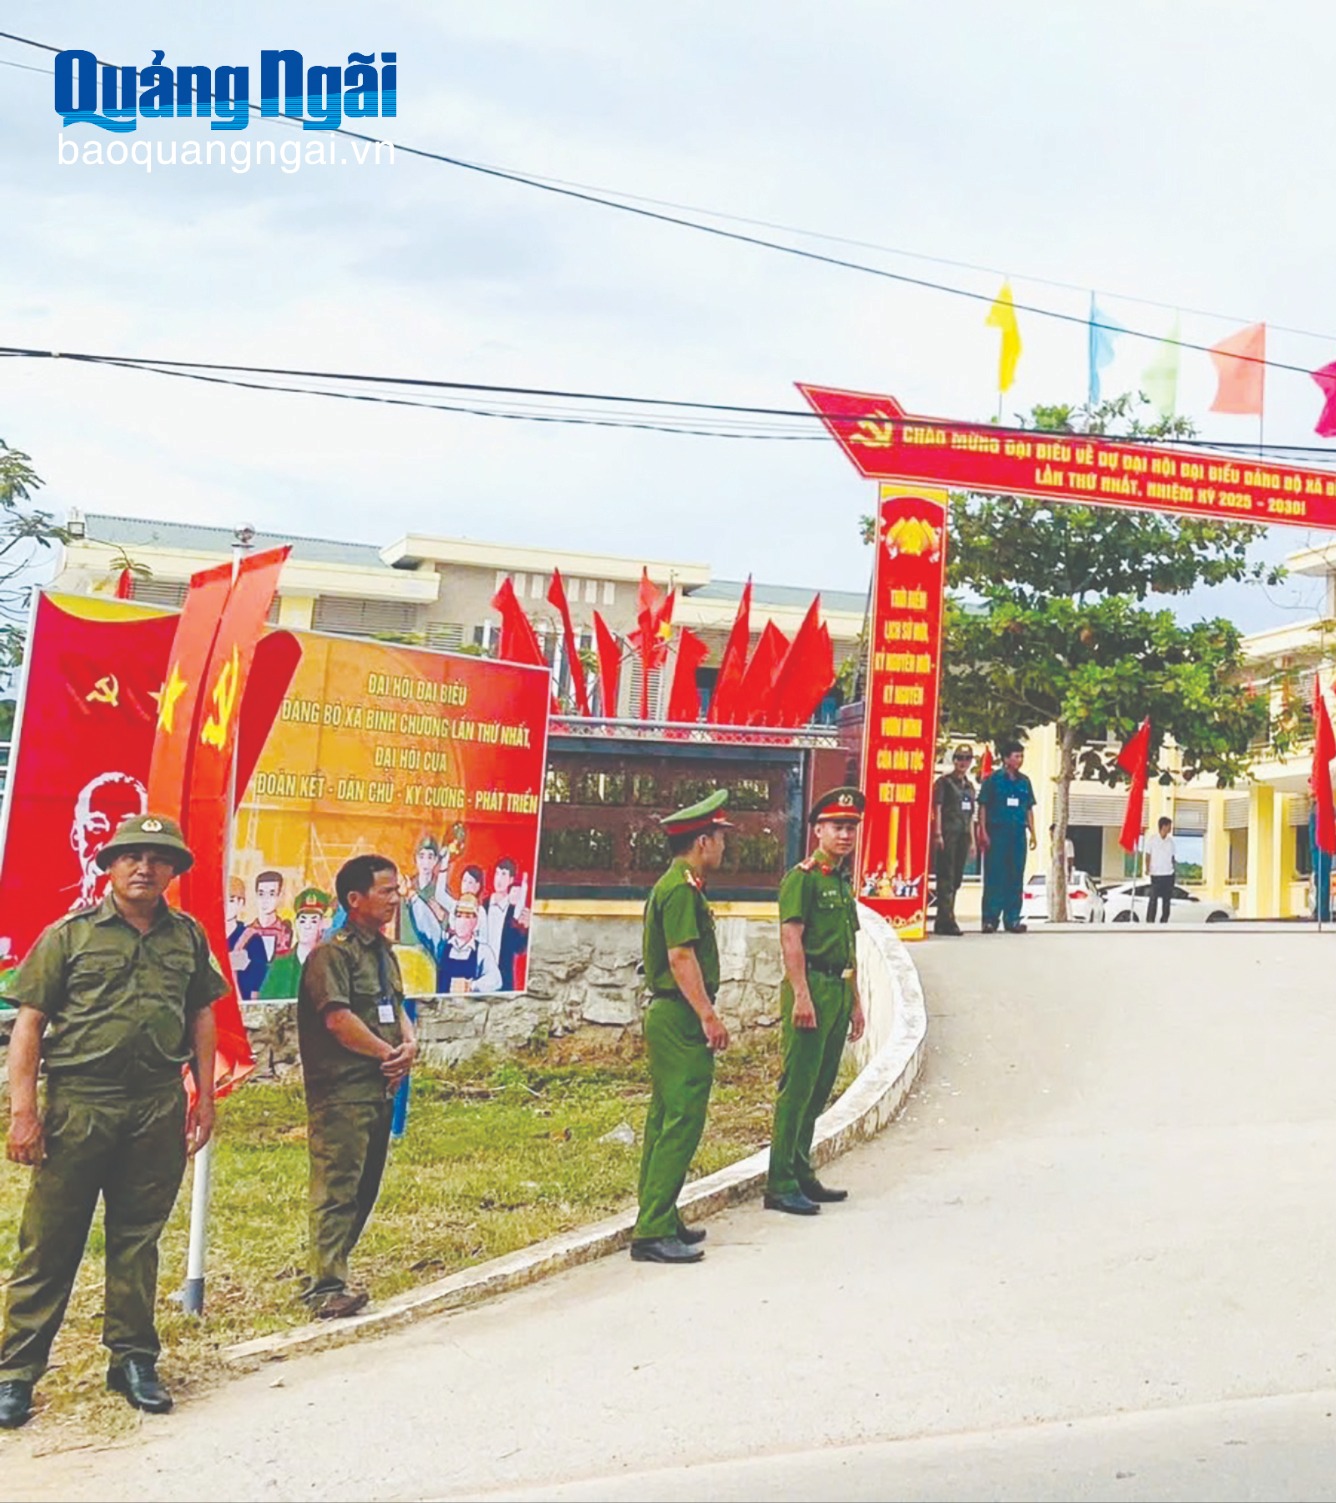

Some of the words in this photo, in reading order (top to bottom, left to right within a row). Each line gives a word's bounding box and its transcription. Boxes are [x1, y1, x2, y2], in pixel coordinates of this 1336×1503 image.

[902, 424, 947, 446] CHÀO
[951, 431, 1000, 455] MỪNG
[1004, 438, 1033, 461] ĐẠI
[1036, 440, 1071, 463] BIỂU
[1075, 443, 1094, 466] VỀ
[1098, 450, 1119, 472] DỰ
[1122, 454, 1148, 476] ĐẠI
[1151, 456, 1176, 478] HỘI
[1180, 461, 1204, 482] ĐẠI
[1208, 462, 1241, 484] BIỂU
[1243, 467, 1281, 490] ĐẢNG
[1283, 474, 1302, 496] BỘ
[1304, 476, 1323, 496] XÃ
[1035, 463, 1064, 487] LẦN
[1067, 471, 1098, 491] THỨ
[1146, 481, 1194, 504] NHIỆM
[1218, 491, 1252, 510] 2025
[367, 672, 390, 697] ĐẠI
[393, 675, 415, 702] HỘI
[416, 678, 438, 706] ĐẠI
[440, 678, 468, 707] BIỂU
[282, 696, 320, 724] ĐẢNG
[323, 700, 342, 731] BỘ
[345, 703, 363, 729] XÃ
[365, 705, 398, 733] BÌNH
[375, 745, 396, 773] ĐẠI
[399, 745, 420, 773] HỘI
[256, 768, 297, 797] ĐOÀN
[300, 769, 326, 798] KẾT
[337, 774, 365, 800] DÂN
[368, 775, 395, 803] CHỦ
[474, 787, 505, 812] PHÁT
[507, 786, 539, 815] TRIỂN
